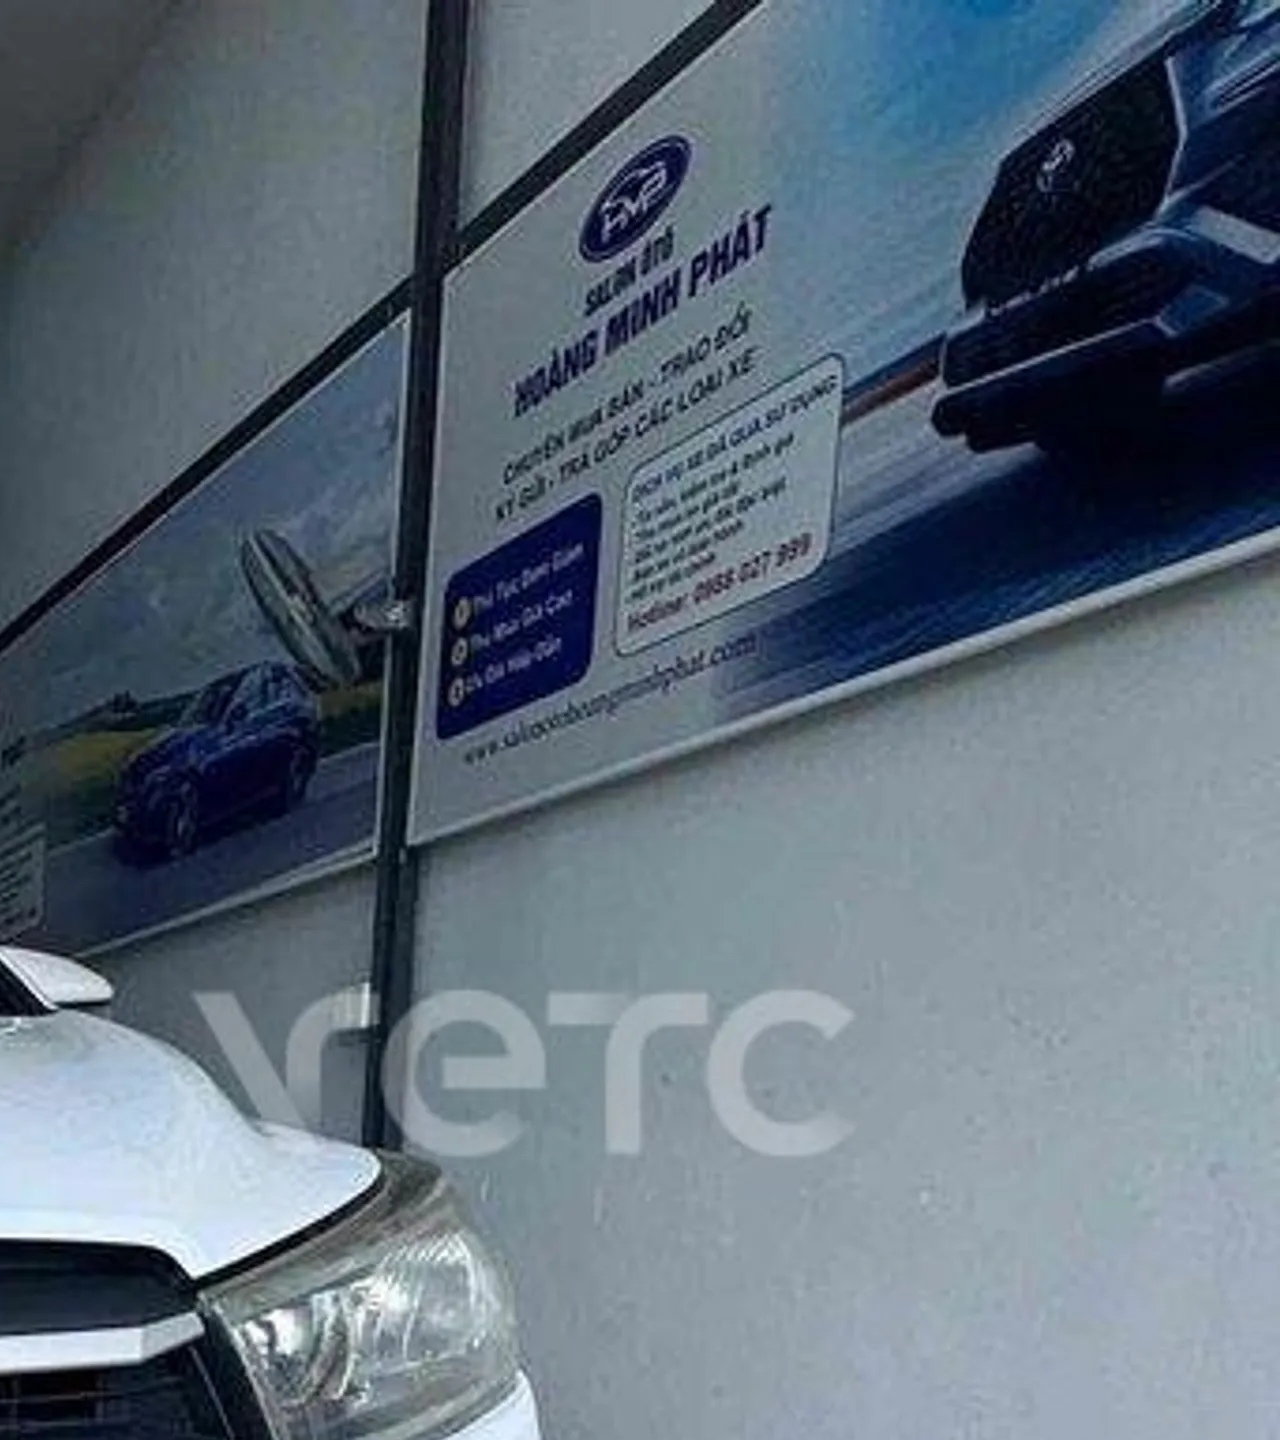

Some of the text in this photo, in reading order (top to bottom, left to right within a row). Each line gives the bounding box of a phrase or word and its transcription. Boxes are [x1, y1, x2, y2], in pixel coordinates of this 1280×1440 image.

[514, 202, 772, 418] HOÀNG MINH PHÁT
[583, 256, 636, 318] SALON
[737, 549, 773, 584] 027
[775, 531, 813, 568] 999
